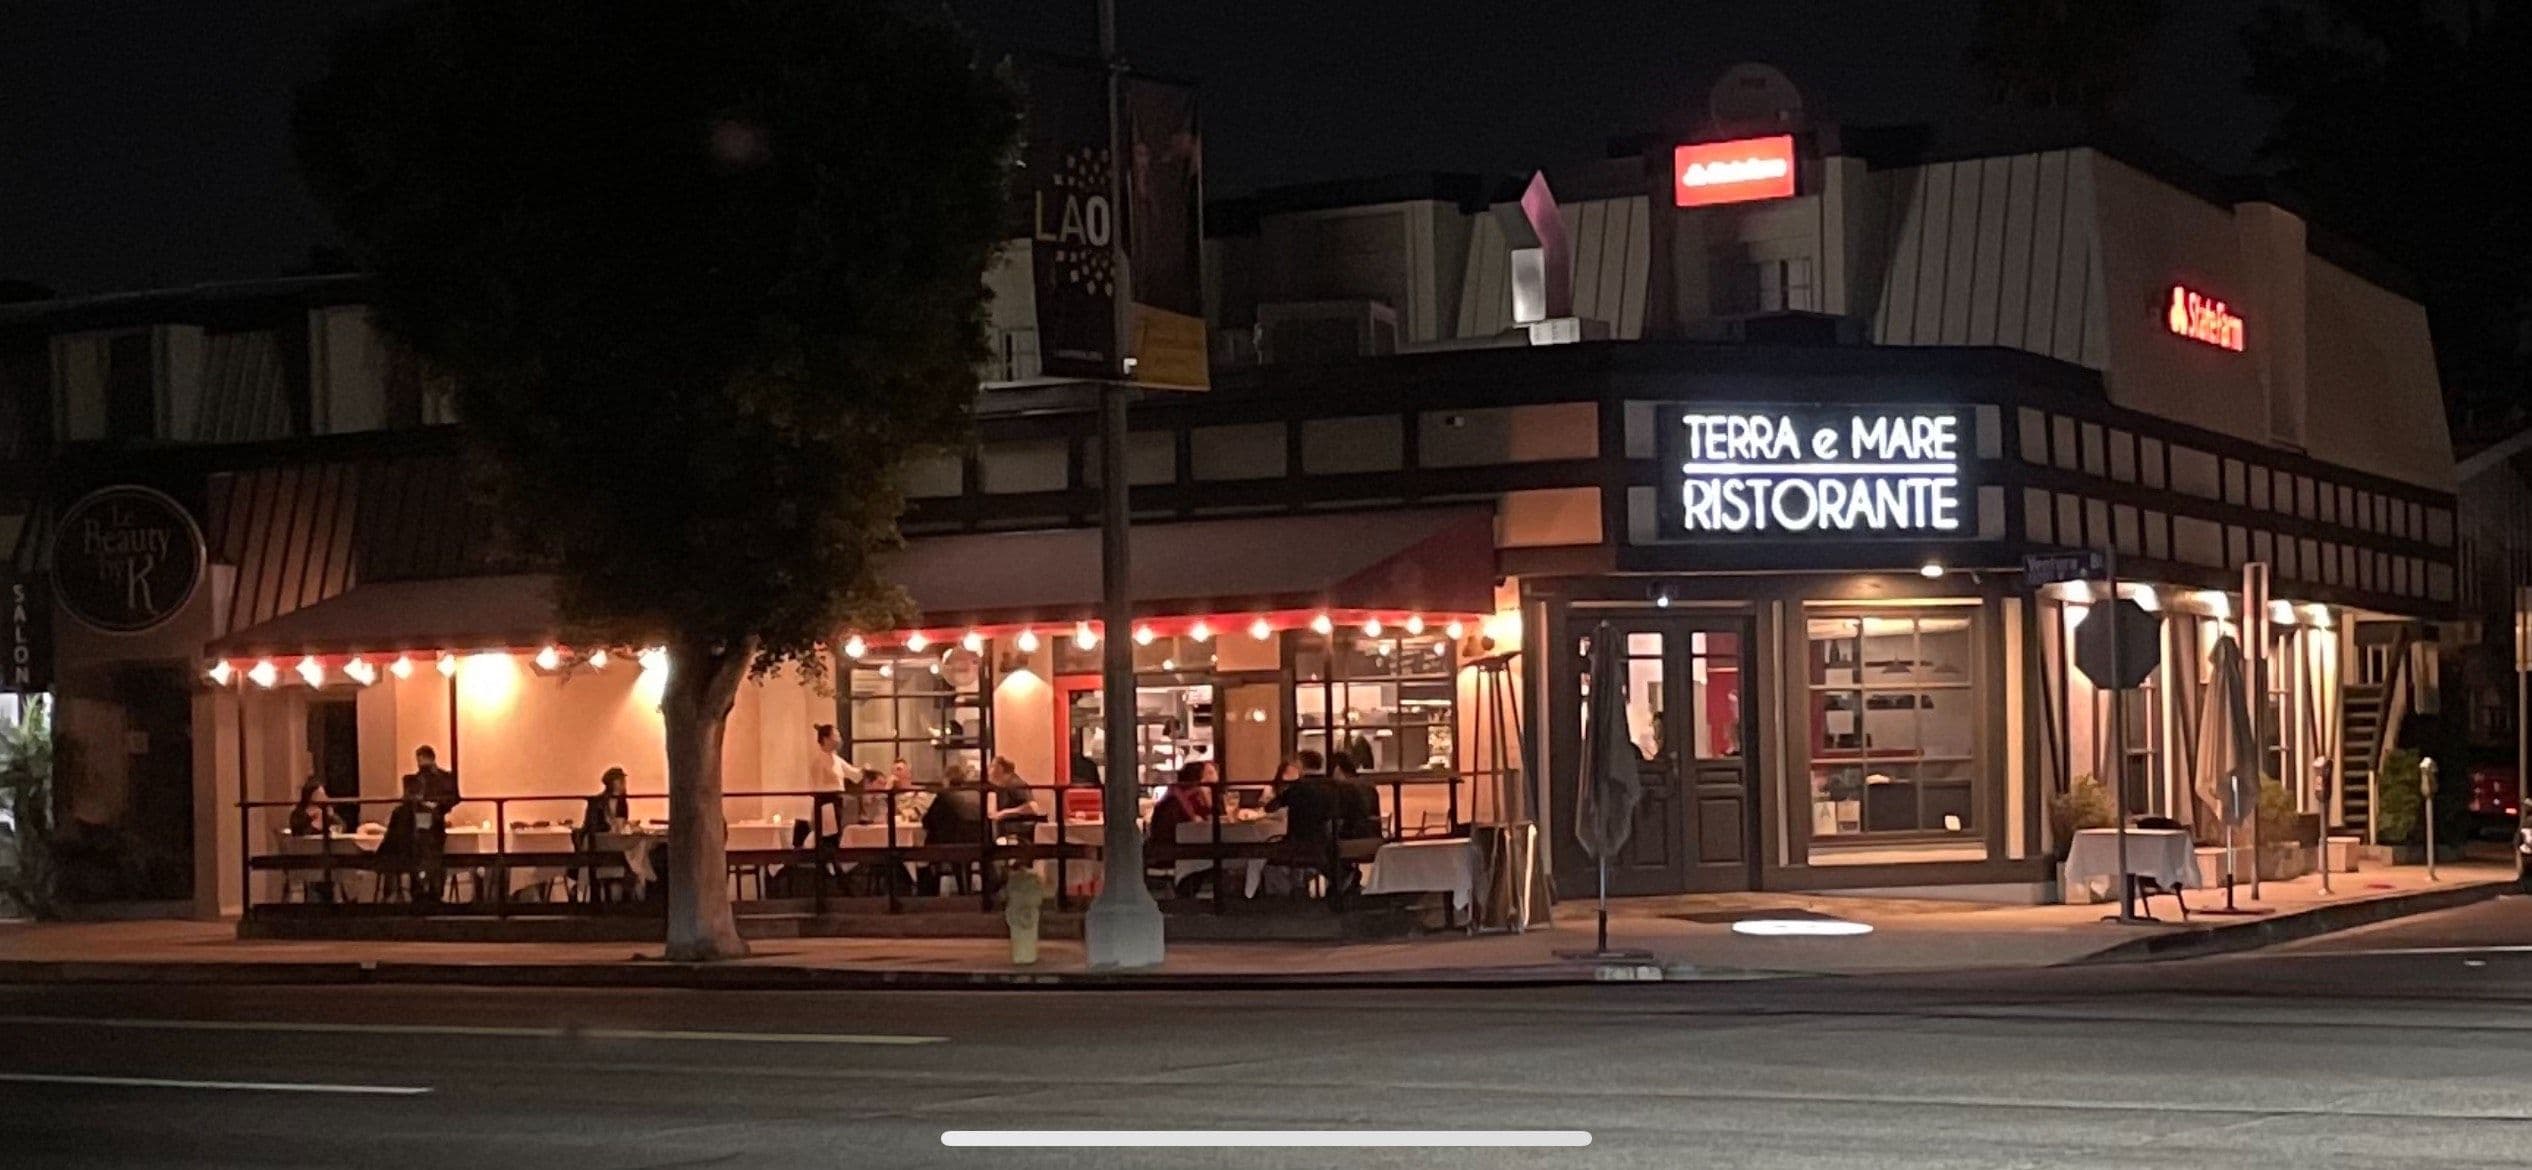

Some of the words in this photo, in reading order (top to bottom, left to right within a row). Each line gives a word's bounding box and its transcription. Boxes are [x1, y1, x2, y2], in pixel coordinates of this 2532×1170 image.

[1682, 414, 1801, 459] TERRA
[1811, 427, 1838, 460] e
[1851, 415, 1957, 460] MARE
[1682, 477, 1959, 531] RISTORANTE
[84, 517, 172, 563] Beauty
[127, 552, 161, 616] K
[13, 583, 31, 685] SALON
